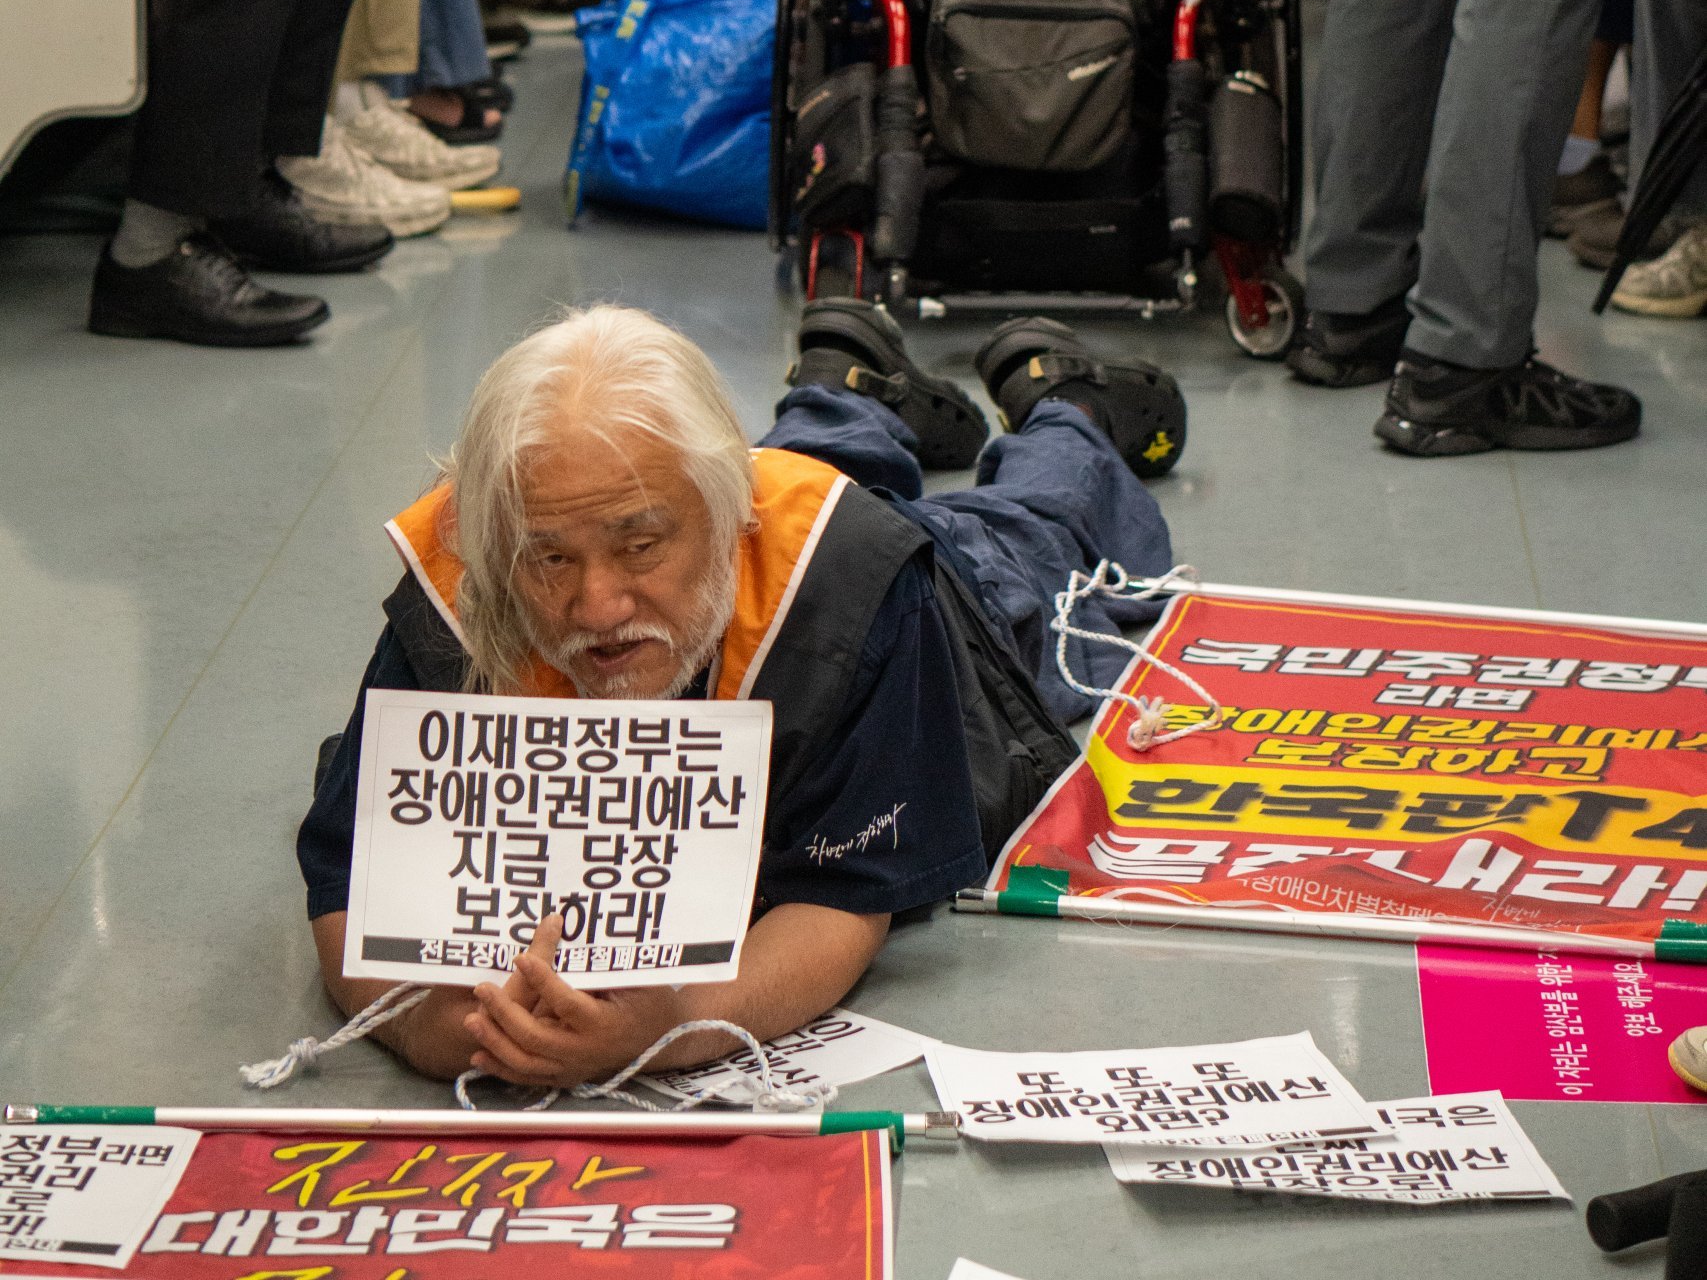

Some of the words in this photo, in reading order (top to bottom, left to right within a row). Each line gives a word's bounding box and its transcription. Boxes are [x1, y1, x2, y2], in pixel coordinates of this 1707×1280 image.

[1182, 638, 1707, 693] 국민주권정
[1376, 683, 1535, 711] 라면
[418, 710, 724, 773] 이재명정부는
[1245, 738, 1609, 783] 보장하고
[387, 768, 747, 830] 장애인권리예산
[448, 831, 550, 888] 지금
[582, 833, 678, 890] 당장
[452, 886, 666, 944] 보장하라!
[420, 939, 683, 973] 전국장애차별철폐연대
[1534, 963, 1574, 986] 위한
[1541, 989, 1585, 1037] 임산부를
[1623, 1012, 1663, 1037] 양보
[1016, 1071, 1084, 1095] 또,
[1192, 1062, 1249, 1083] 또
[1551, 1041, 1591, 1079] 자리는
[962, 1076, 1332, 1124] 장애인권리예산
[1556, 1082, 1594, 1096] 이
[1095, 1108, 1230, 1133] 외면?
[267, 1141, 645, 1207] 진짜
[1147, 1147, 1510, 1180] 장애인권리예산
[141, 1204, 737, 1257] 대한민국은
